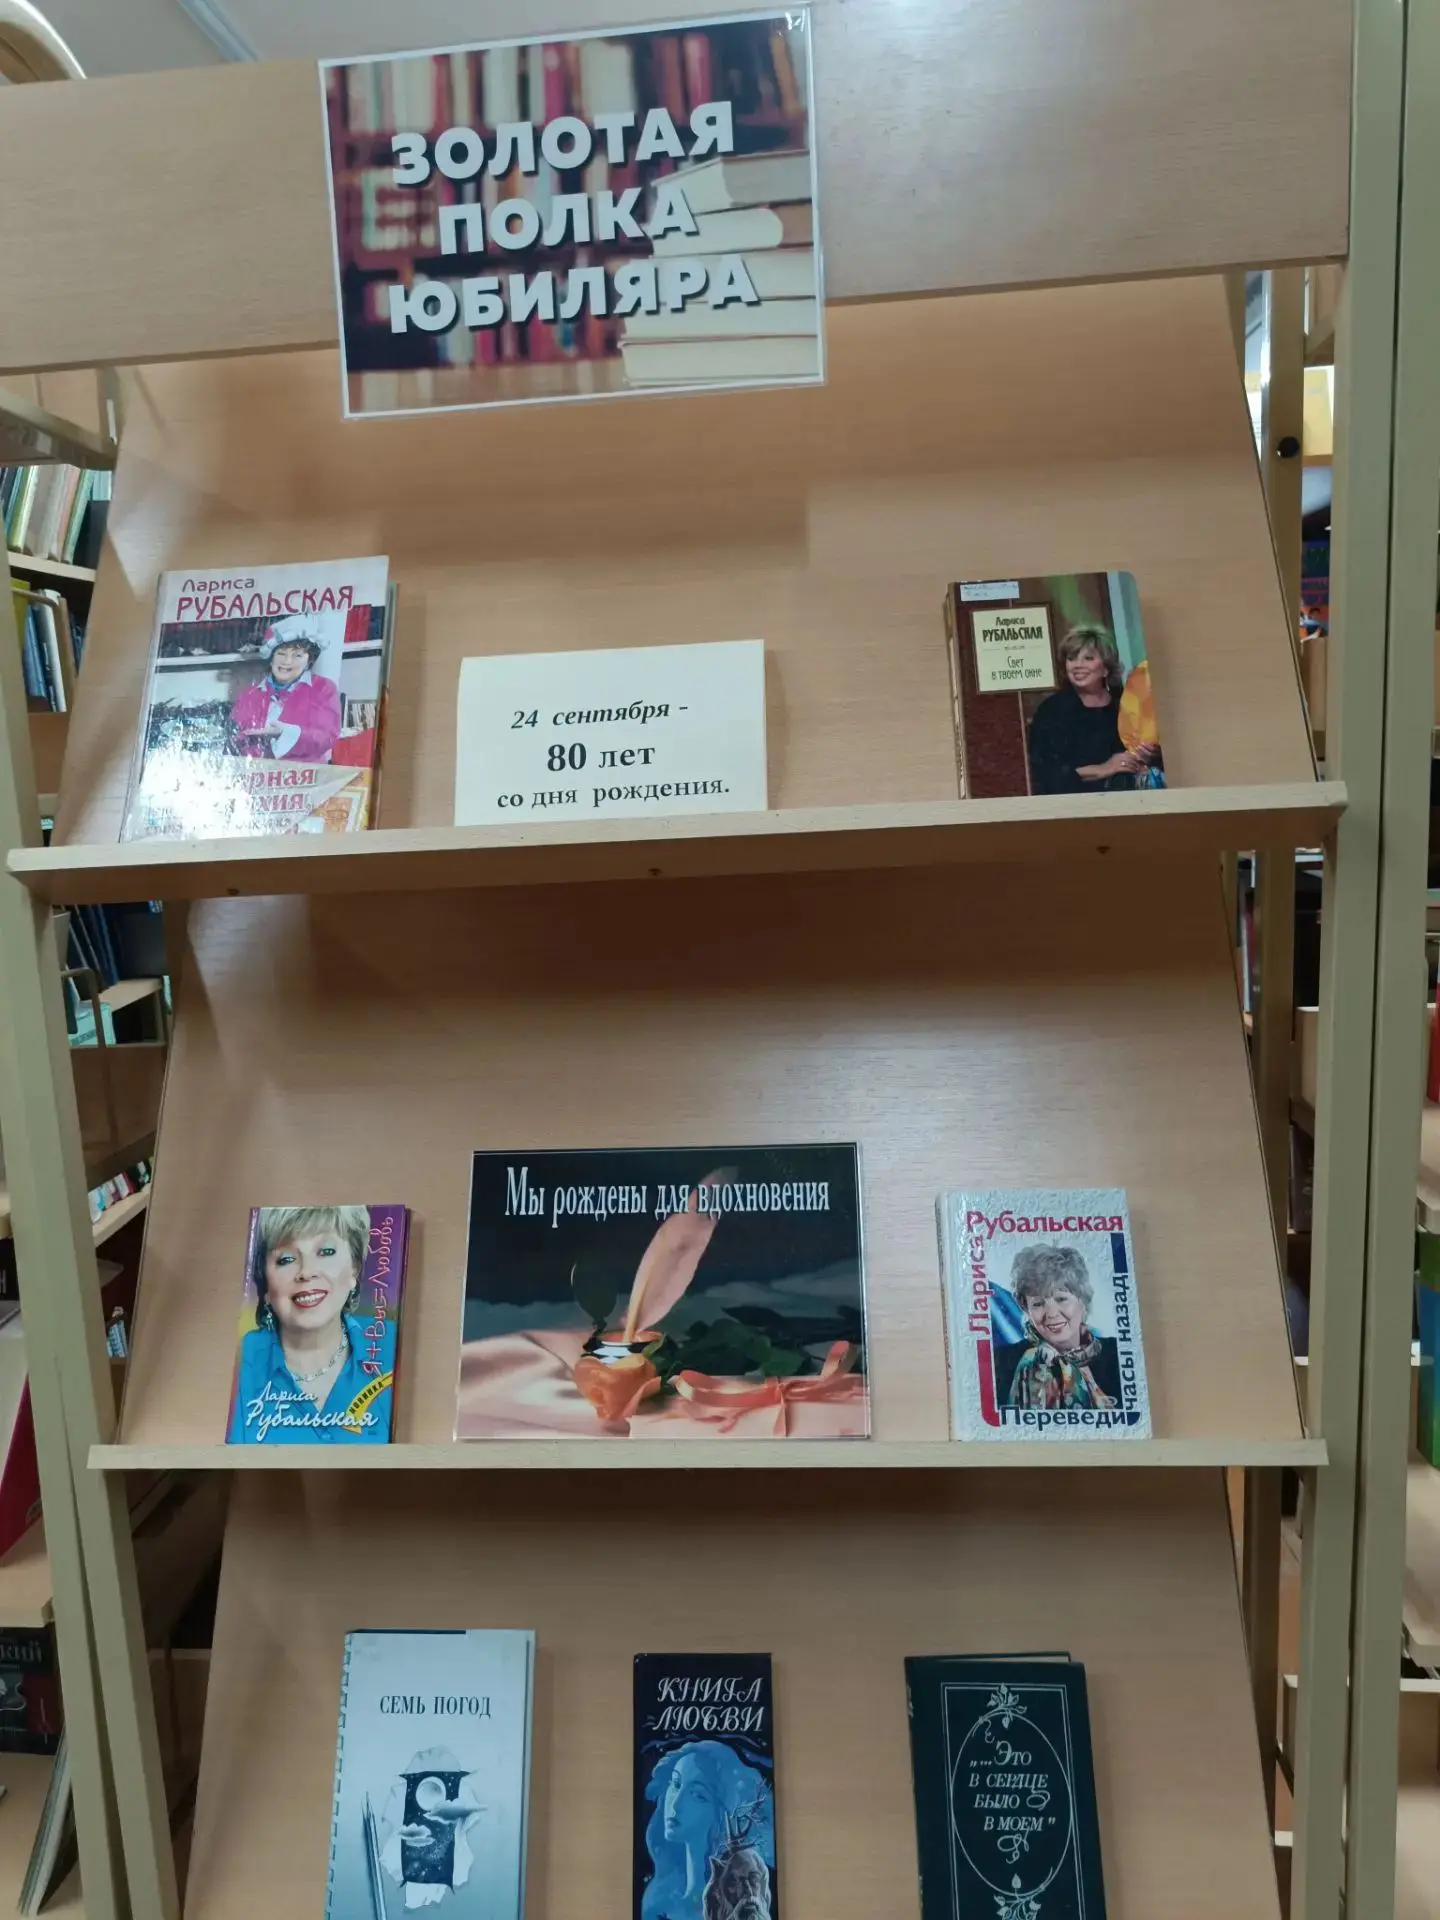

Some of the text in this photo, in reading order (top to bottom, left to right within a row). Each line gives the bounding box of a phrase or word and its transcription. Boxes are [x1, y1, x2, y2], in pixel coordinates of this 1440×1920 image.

[391, 101, 735, 186] ЗОЛОТАЯ
[438, 187, 699, 255] ПОЛКА
[389, 254, 759, 334] ЮБИЛЯРА
[182, 577, 256, 594] Лариса
[176, 585, 354, 621] РУБАЛЬСКАЯ
[982, 626, 1043, 642] РУБАЛЬСКАЯ
[510, 708, 539, 729] 24
[552, 700, 670, 726] сентября
[547, 742, 656, 772] 80 лет
[497, 778, 730, 809] со дня рождения.
[505, 1166, 831, 1228] Мы рождены для вдохновения
[967, 1210, 1124, 1240] Рубальская
[969, 1234, 995, 1336] Лариса
[1111, 1273, 1138, 1411] часы назад
[258, 1380, 319, 1409] Лариса
[245, 1401, 379, 1443] Рубальская
[1001, 1405, 1127, 1431] Переведи
[656, 1676, 764, 1703] КНИГА
[380, 1695, 491, 1719] СЕМЬ ПОГОД
[652, 1706, 766, 1732] ЛЮБВИ
[986, 1773, 1048, 1792] СЕРДЦЕ
[974, 1794, 1020, 1809] БЫЛО
